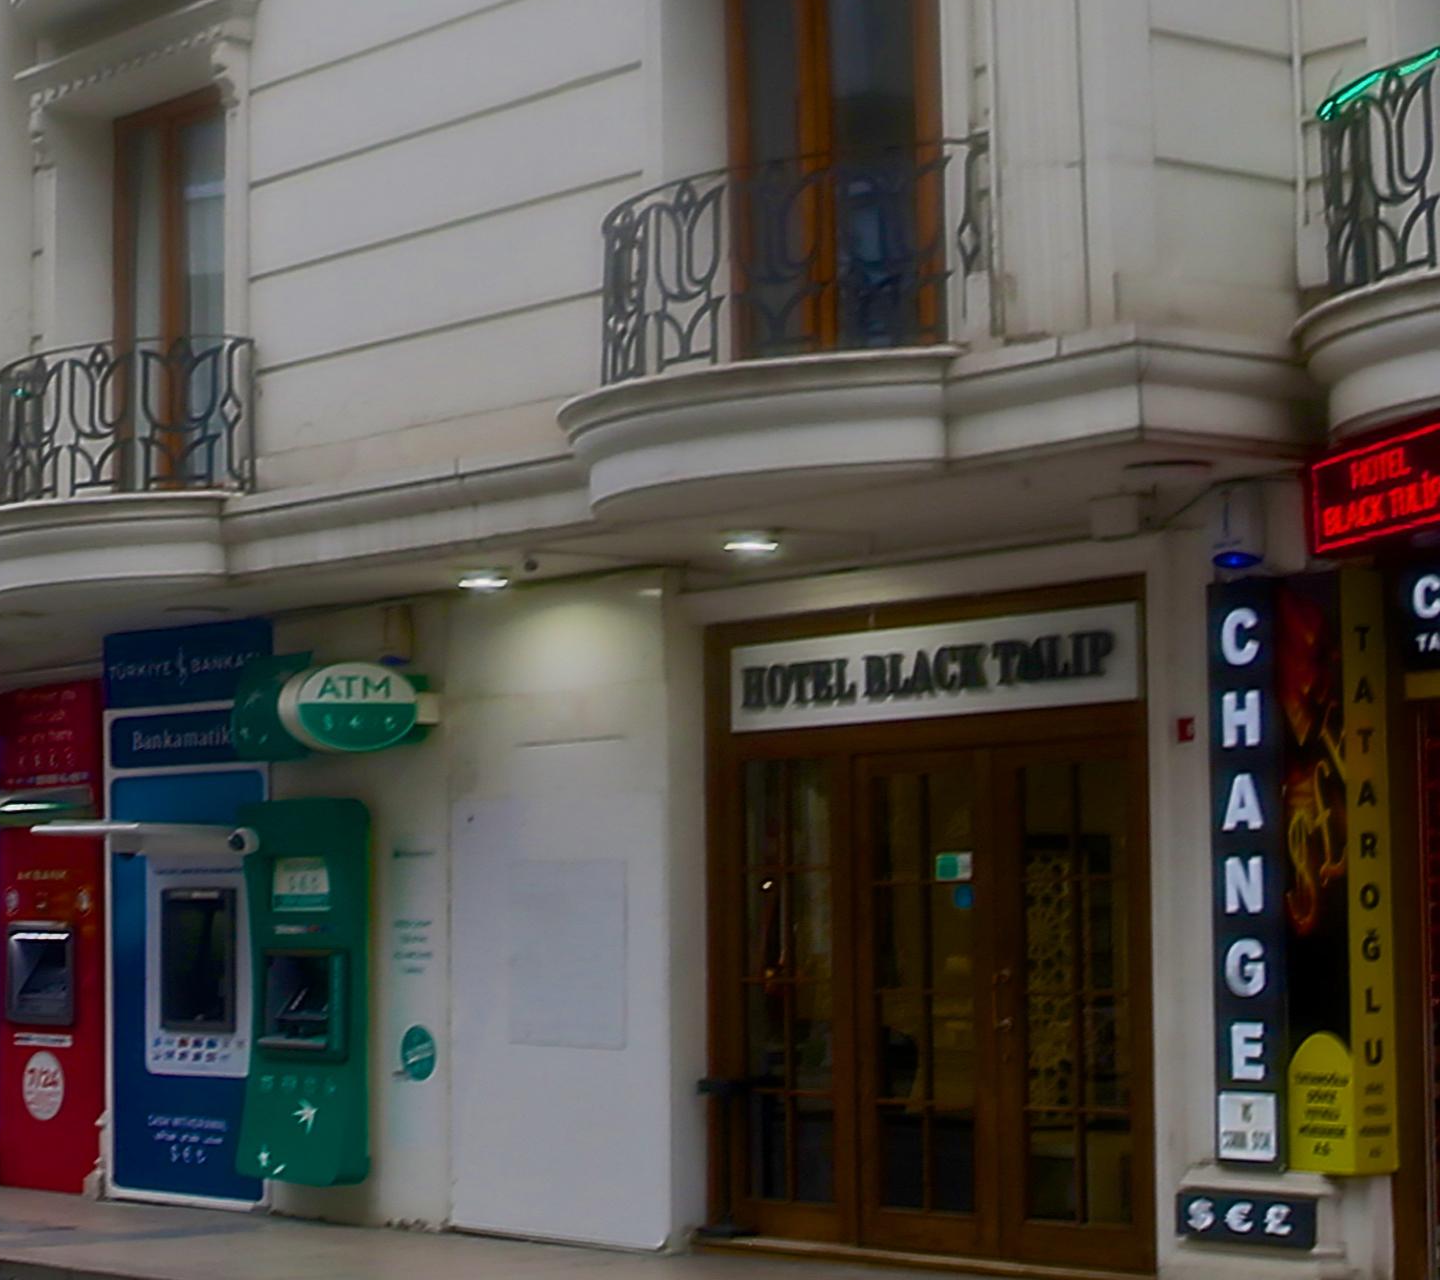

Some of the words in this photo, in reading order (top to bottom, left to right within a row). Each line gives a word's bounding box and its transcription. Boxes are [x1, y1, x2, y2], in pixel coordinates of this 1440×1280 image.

[1351, 447, 1411, 489] HOTEL
[1322, 492, 1383, 537] BLACK
[317, 676, 392, 700] ATM
[741, 659, 855, 710] HOTEL
[862, 644, 991, 697] BLACK
[993, 631, 1115, 685] TULIP
[132, 724, 230, 751] Bankamatik
[1221, 607, 1266, 1083] CHANGE
[1354, 624, 1383, 1066] TATAROĞLU
